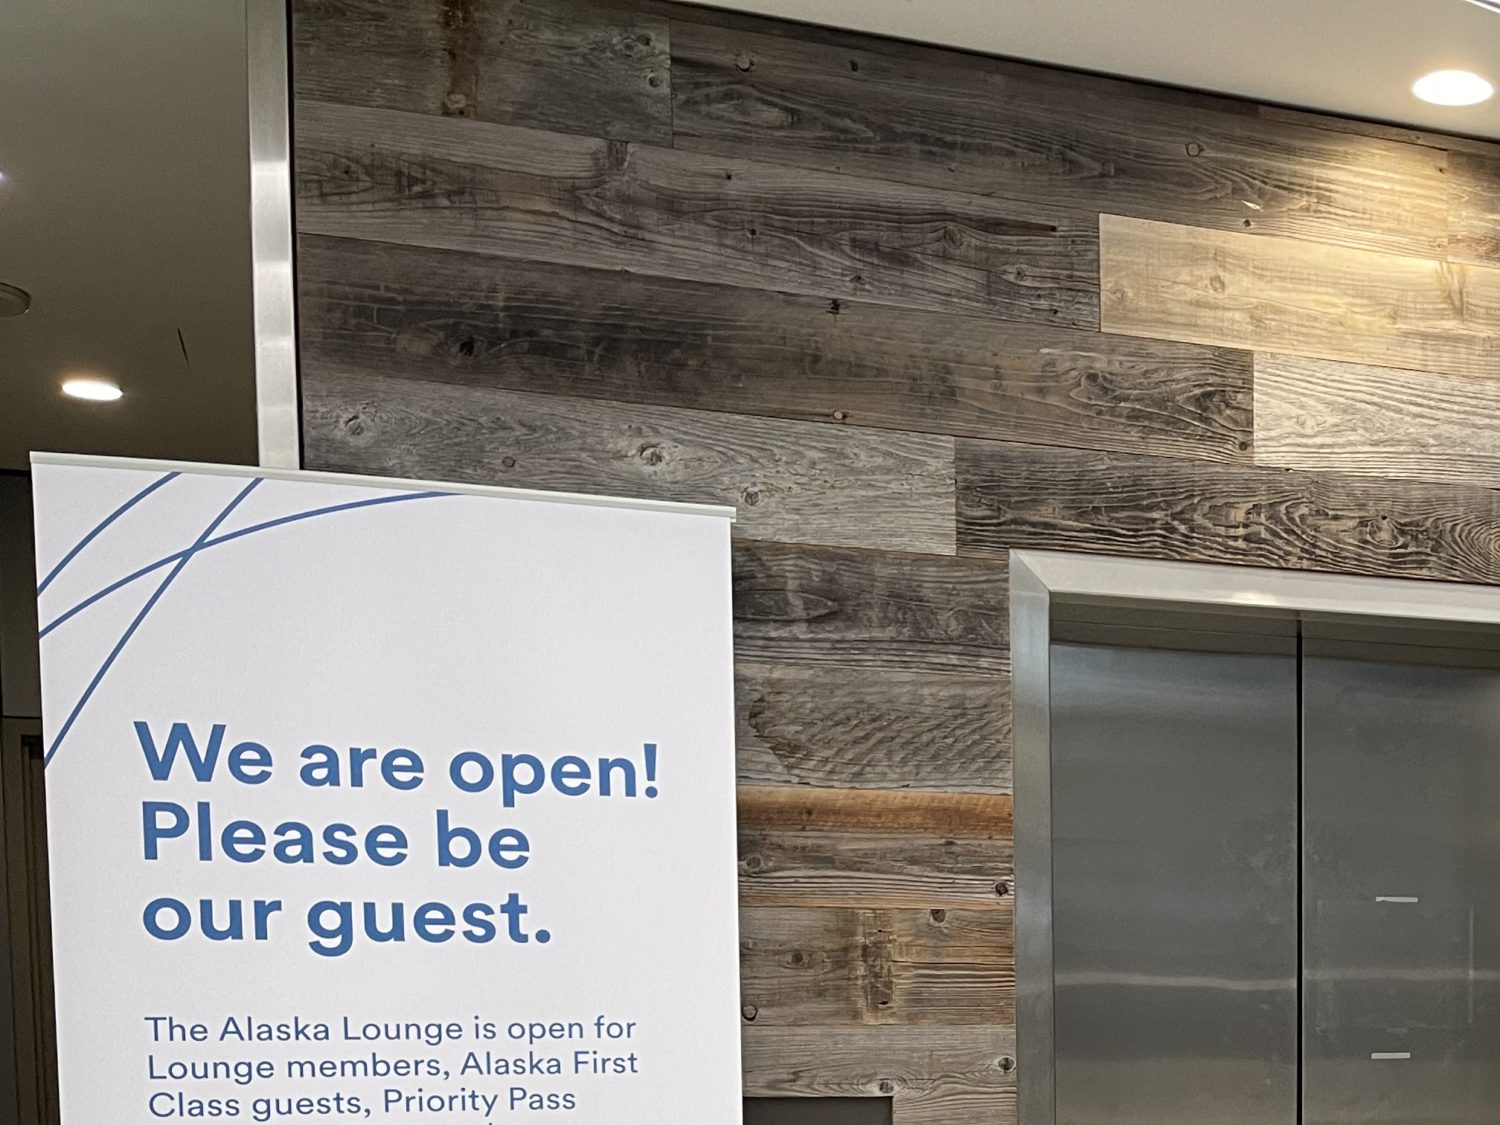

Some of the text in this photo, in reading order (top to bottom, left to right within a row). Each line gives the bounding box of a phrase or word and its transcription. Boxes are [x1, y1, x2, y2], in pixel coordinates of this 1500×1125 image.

[132, 720, 659, 809] We are open!
[141, 800, 531, 870] Please be
[142, 892, 552, 958] our guest.
[143, 1014, 637, 1047] The Alaska Lounge is open for
[148, 1049, 639, 1086] Lounge members, Alaska First
[148, 1086, 576, 1123] Class guests, Priority Pass
